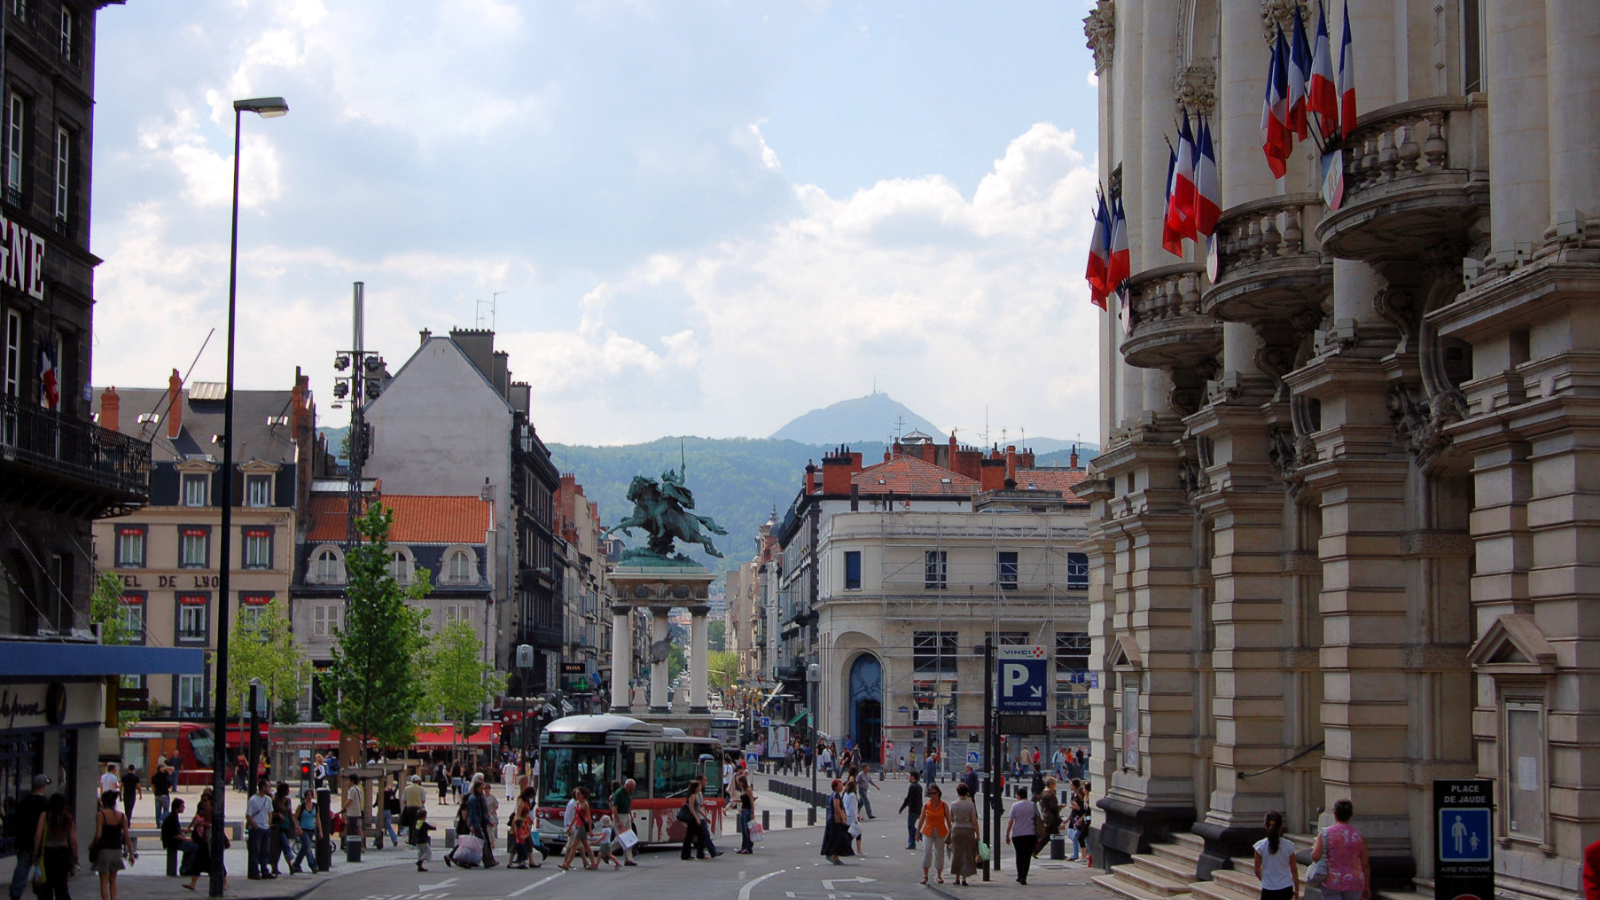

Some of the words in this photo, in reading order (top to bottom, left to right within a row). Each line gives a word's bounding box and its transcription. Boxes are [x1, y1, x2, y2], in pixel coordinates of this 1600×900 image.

[158, 575, 177, 588] DE
[194, 575, 219, 588] LYO
[1004, 664, 1029, 697] P
[1451, 785, 1480, 793] PLACE
